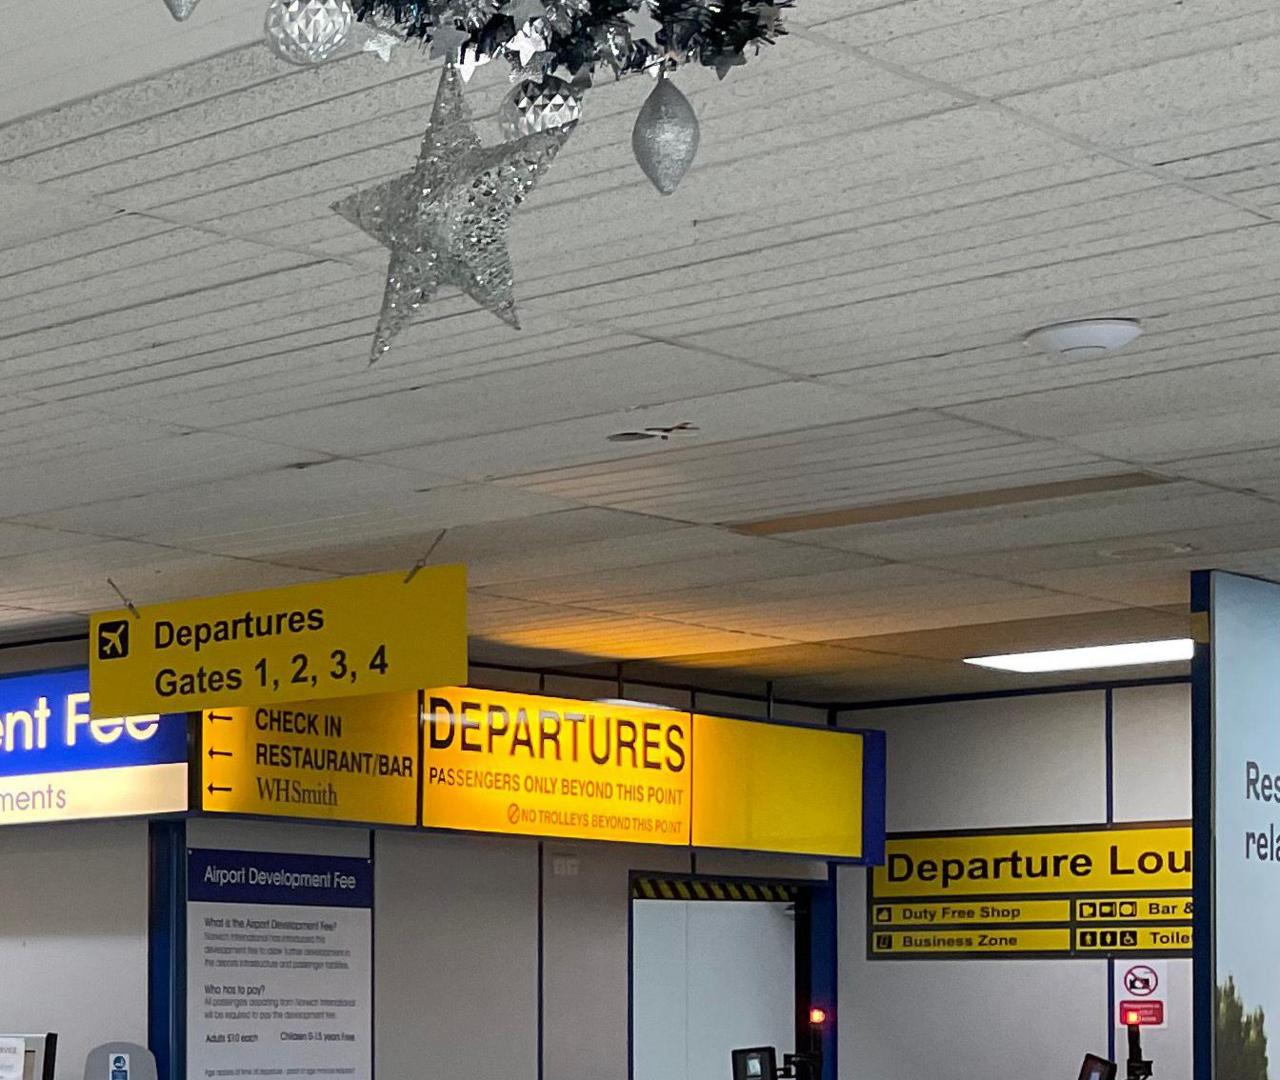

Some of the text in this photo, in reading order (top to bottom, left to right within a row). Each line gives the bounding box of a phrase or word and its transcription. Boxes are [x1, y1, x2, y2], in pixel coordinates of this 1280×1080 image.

[154, 608, 325, 652] Departures
[154, 645, 389, 698] Gates 1, 2, 3, 4
[64, 691, 161, 747] Fee
[255, 708, 342, 738] CHECK IN
[429, 696, 685, 773] DEPARTURES
[256, 743, 413, 778] RESTAURANT/BAR
[256, 776, 338, 806] WHSmith
[429, 767, 684, 805] PASSENGERS ONLY BEYOND THIS POINT
[521, 809, 682, 834] NO TROLLEYS BEYOND THIS POINT
[204, 865, 357, 889] Airport Development Fee
[887, 849, 1093, 888] Departure
[902, 905, 1020, 922] Duty Free Shop
[1148, 902, 1177, 914] Bar
[903, 934, 1018, 947] Business Zone
